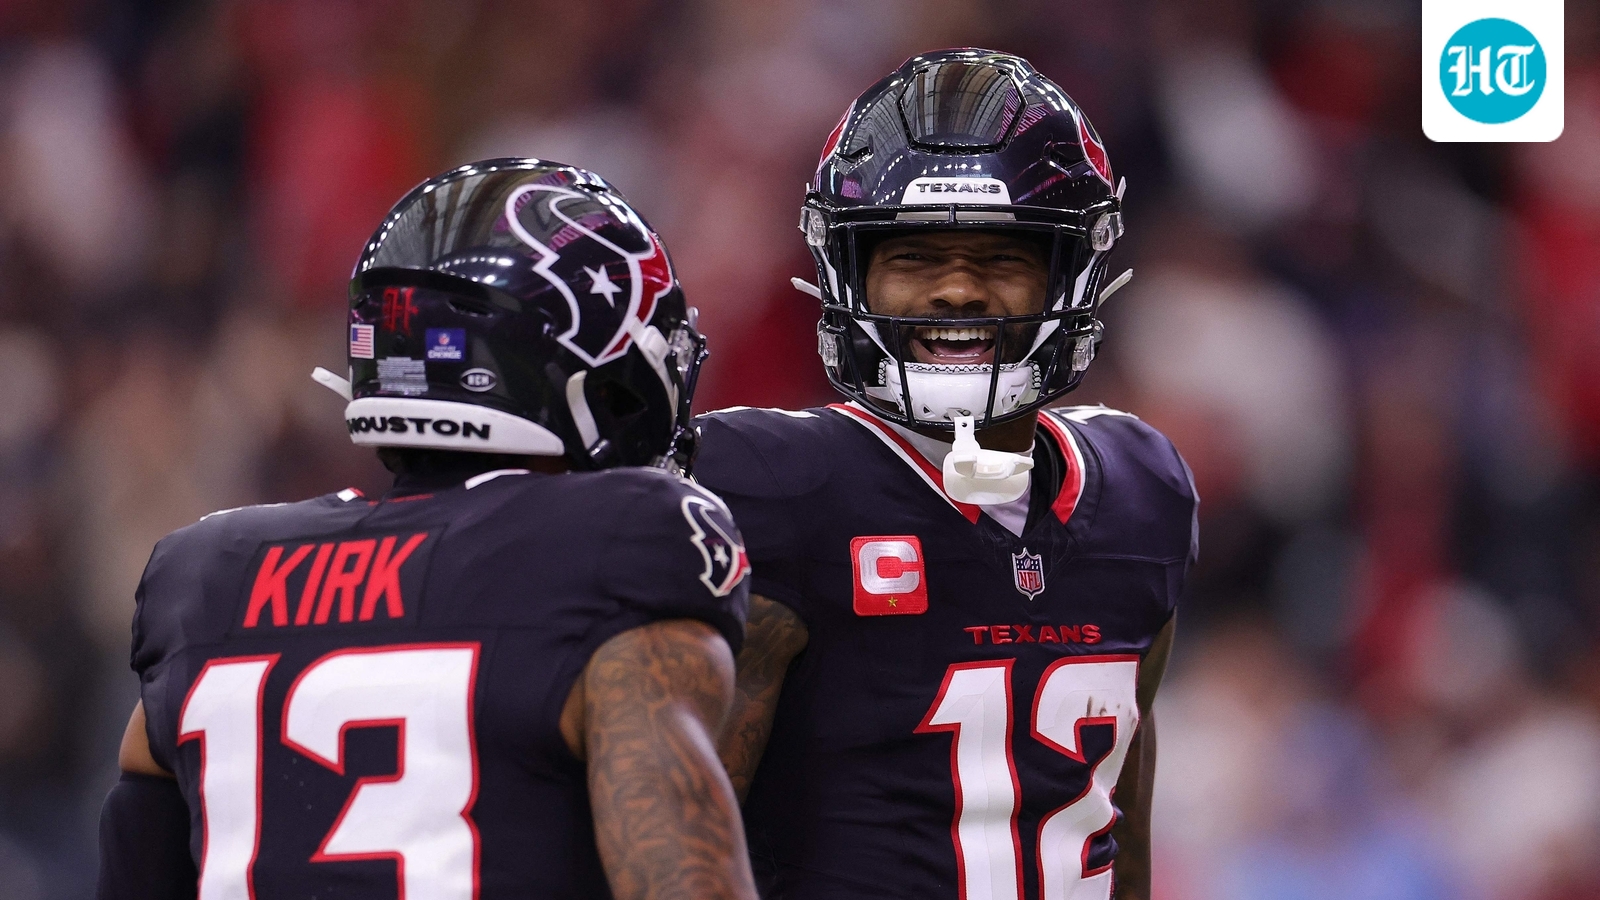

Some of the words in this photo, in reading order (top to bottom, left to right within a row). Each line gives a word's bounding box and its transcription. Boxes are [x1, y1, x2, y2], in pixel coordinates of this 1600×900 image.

[915, 182, 1002, 194] TEXANS
[346, 416, 491, 440] HOUSTON
[243, 532, 428, 628] KIRK
[858, 540, 921, 595] C
[1018, 571, 1042, 591] NFL
[963, 624, 1102, 645] TEXANS
[177, 641, 481, 900] 13
[912, 653, 1141, 900] 12
